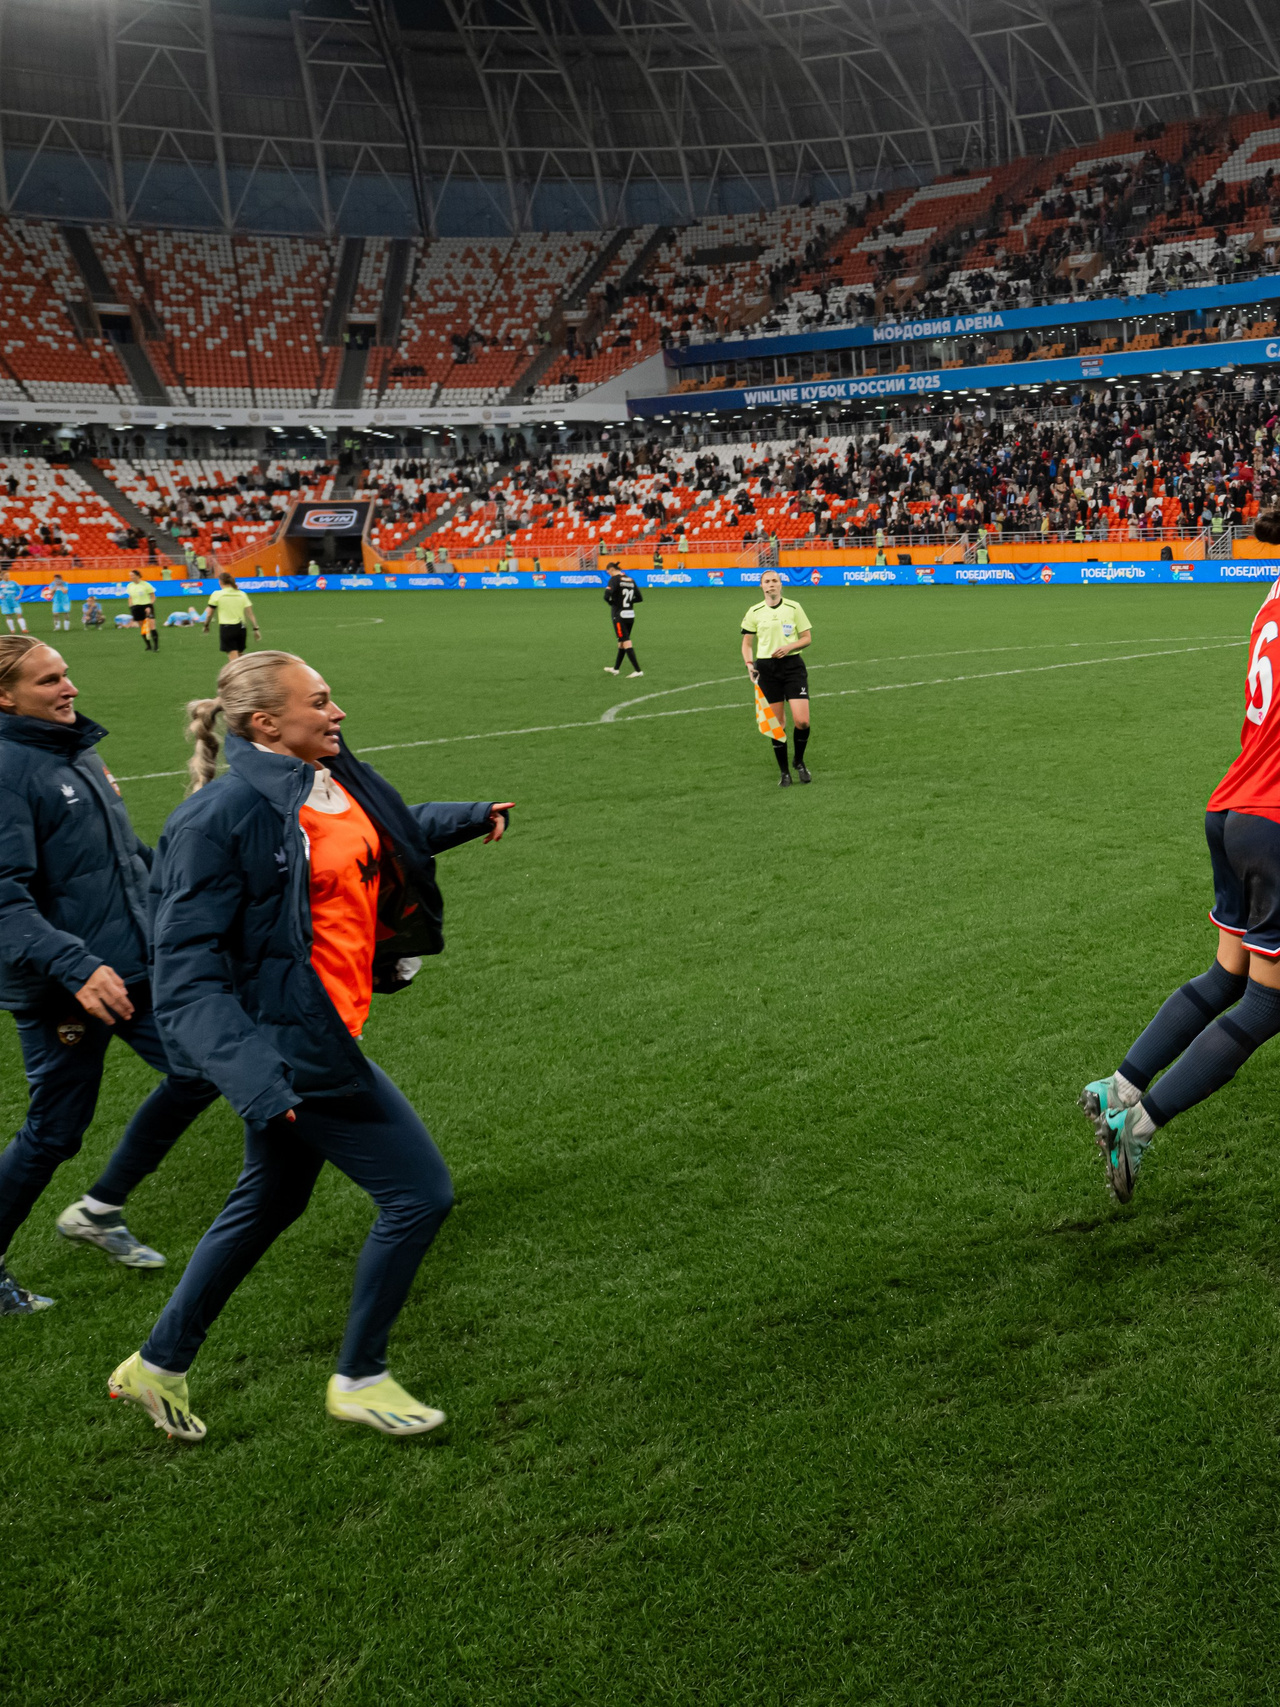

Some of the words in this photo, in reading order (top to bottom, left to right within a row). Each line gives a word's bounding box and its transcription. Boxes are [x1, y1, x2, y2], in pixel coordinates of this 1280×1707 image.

[873, 319, 951, 341] МОРДОВИЯ
[955, 314, 1004, 332] АРЕНА
[744, 388, 798, 404] WINLINE
[801, 383, 846, 400] КУБОК
[850, 378, 905, 396] РОССИИ
[908, 375, 941, 390] 2025
[741, 572, 788, 582] ПОБЕЛЬ
[844, 571, 896, 582] ПОБЕДИТЕЛЬ
[956, 570, 1014, 580] ПОБЕДИТЕЛЬ
[1081, 568, 1145, 579] ПОБЕДИТЕЛЬ
[622, 588, 634, 608] 21
[1246, 621, 1278, 726] 6
